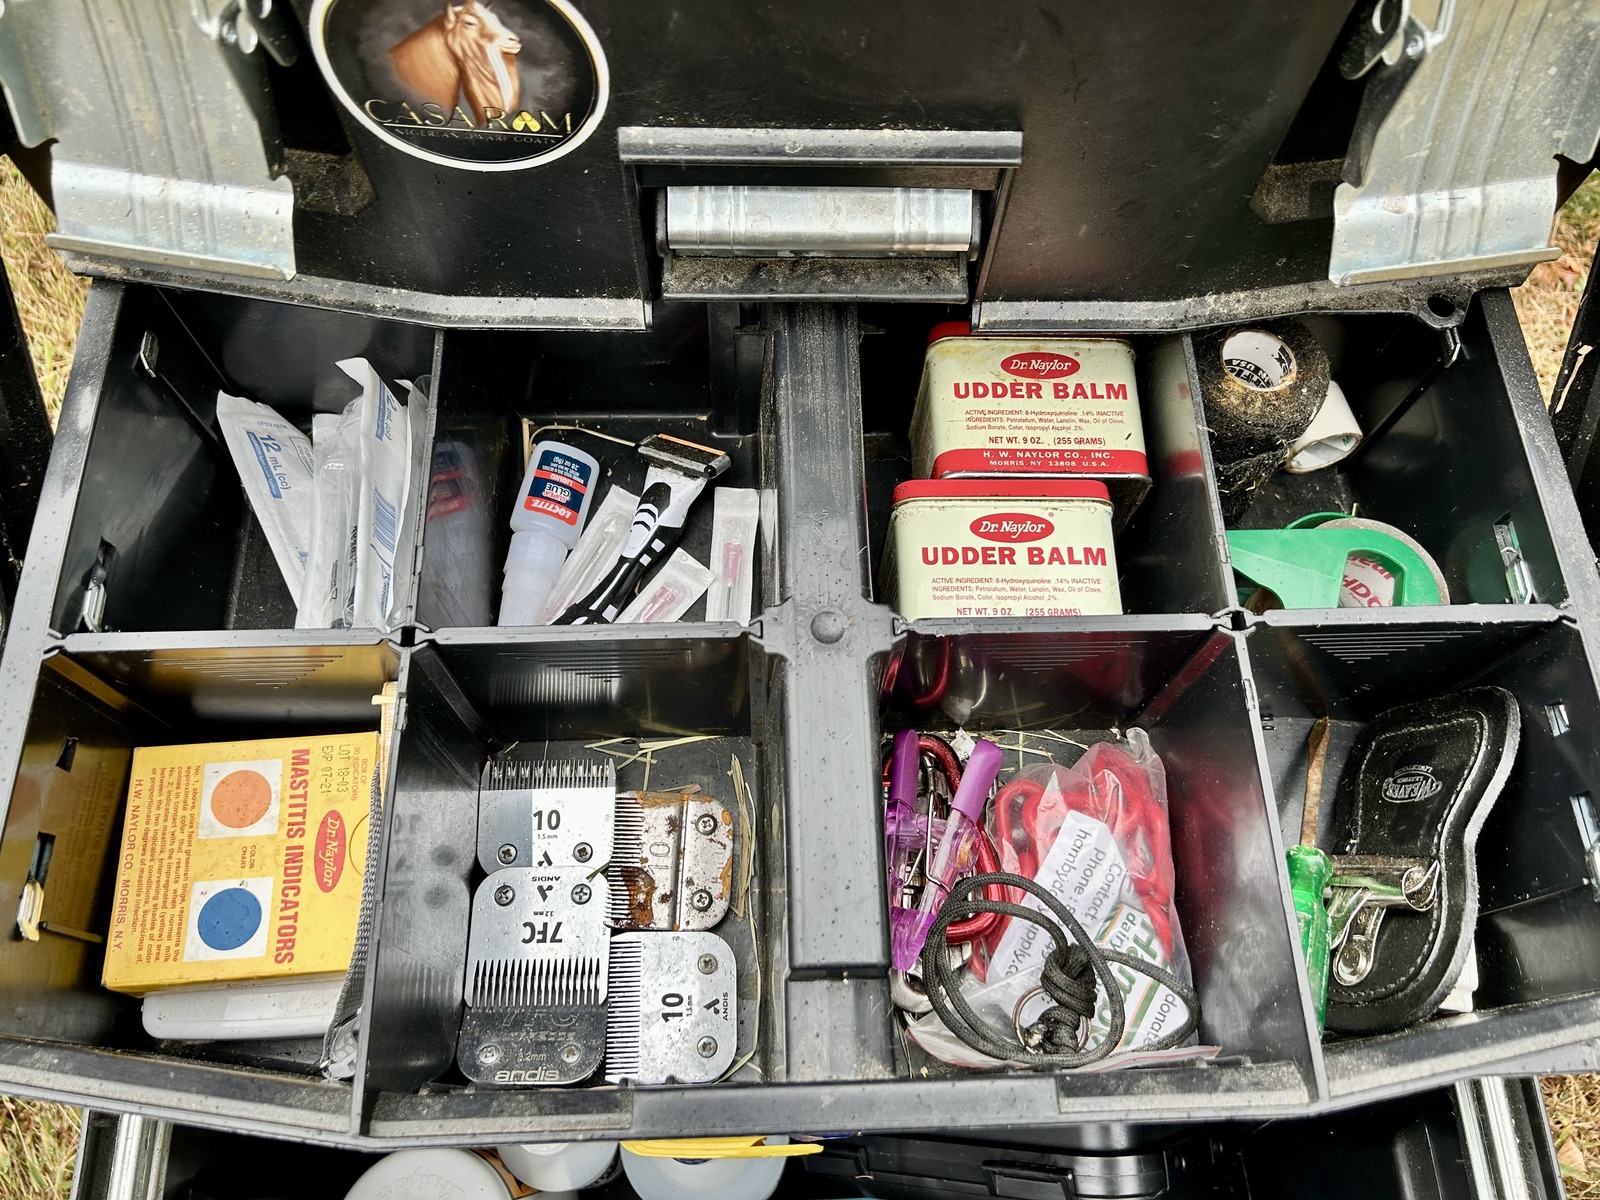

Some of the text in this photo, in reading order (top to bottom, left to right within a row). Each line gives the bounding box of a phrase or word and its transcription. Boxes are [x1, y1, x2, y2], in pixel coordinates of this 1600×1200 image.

[364, 100, 475, 130] CASA
[514, 136, 556, 144] GOATS
[1010, 360, 1072, 374] Dr. Naylor
[1232, 360, 1256, 370] USA
[953, 382, 1128, 400] UDDER BALM
[1024, 410, 1078, 418] 8-Hydroxyquinoline
[260, 434, 282, 452] 12
[988, 436, 1004, 444] NET
[1053, 437, 1072, 446] (255
[1074, 437, 1106, 446] GRAMS)
[269, 456, 282, 471] mL
[275, 473, 291, 490] (cc)
[544, 482, 571, 497] GLUE
[550, 474, 573, 486] LIQUID
[531, 499, 572, 519] LOCTITE
[978, 521, 1046, 539] Dr. Naylor
[922, 547, 1108, 566] UDDER BALM
[995, 578, 1051, 586] 8-Hydroxyquinoline
[1084, 586, 1102, 594] Clove,
[995, 594, 1022, 602] Isopropyl
[1026, 608, 1045, 616] (255
[1047, 608, 1081, 617] GRAMS)
[322, 746, 334, 761] EXP
[337, 744, 351, 793] LOT 18-03
[351, 746, 360, 801] 30 INDICATORS
[158, 768, 166, 796] between
[182, 766, 192, 811] approximate
[360, 775, 367, 786] OF
[1382, 778, 1442, 802] WEAVER
[145, 777, 156, 825] proportionate
[163, 790, 172, 822] indicates
[190, 788, 198, 811] above,
[172, 801, 180, 827] contact
[188, 814, 196, 829] plus
[533, 810, 561, 830] 10
[141, 827, 150, 856] degrees
[150, 829, 160, 862] indicates
[158, 825, 168, 855] mastitis,
[170, 830, 178, 845] with
[177, 839, 185, 854] that
[187, 831, 195, 847] faint
[140, 858, 146, 866] of
[240, 846, 248, 869] CHART
[274, 748, 310, 964] MASTITIS INDICATORS
[318, 817, 340, 887] Dr. Naylor
[649, 841, 670, 871] 10
[112, 779, 144, 953] H.W. NAYLOR CO., MORRIS, N.Y.
[174, 858, 182, 884] results
[183, 850, 192, 881] greenish
[1074, 848, 1107, 895] Phone
[136, 868, 145, 897] mastitis
[143, 865, 154, 906] conditions,
[153, 858, 164, 900] intervening
[162, 862, 173, 909] impregnated
[180, 884, 188, 904] tinge,
[1084, 863, 1122, 922] Contact
[131, 900, 141, 934] infection.
[150, 903, 159, 930] shades
[156, 912, 167, 941] (yellow)
[167, 914, 175, 940] normal
[174, 907, 185, 949] represents
[138, 910, 149, 951] suspicious
[149, 933, 155, 941] of
[521, 922, 563, 944] 7FC
[1109, 912, 1136, 949] dairy
[662, 993, 684, 1023] 10
[494, 1066, 560, 1082] andis
